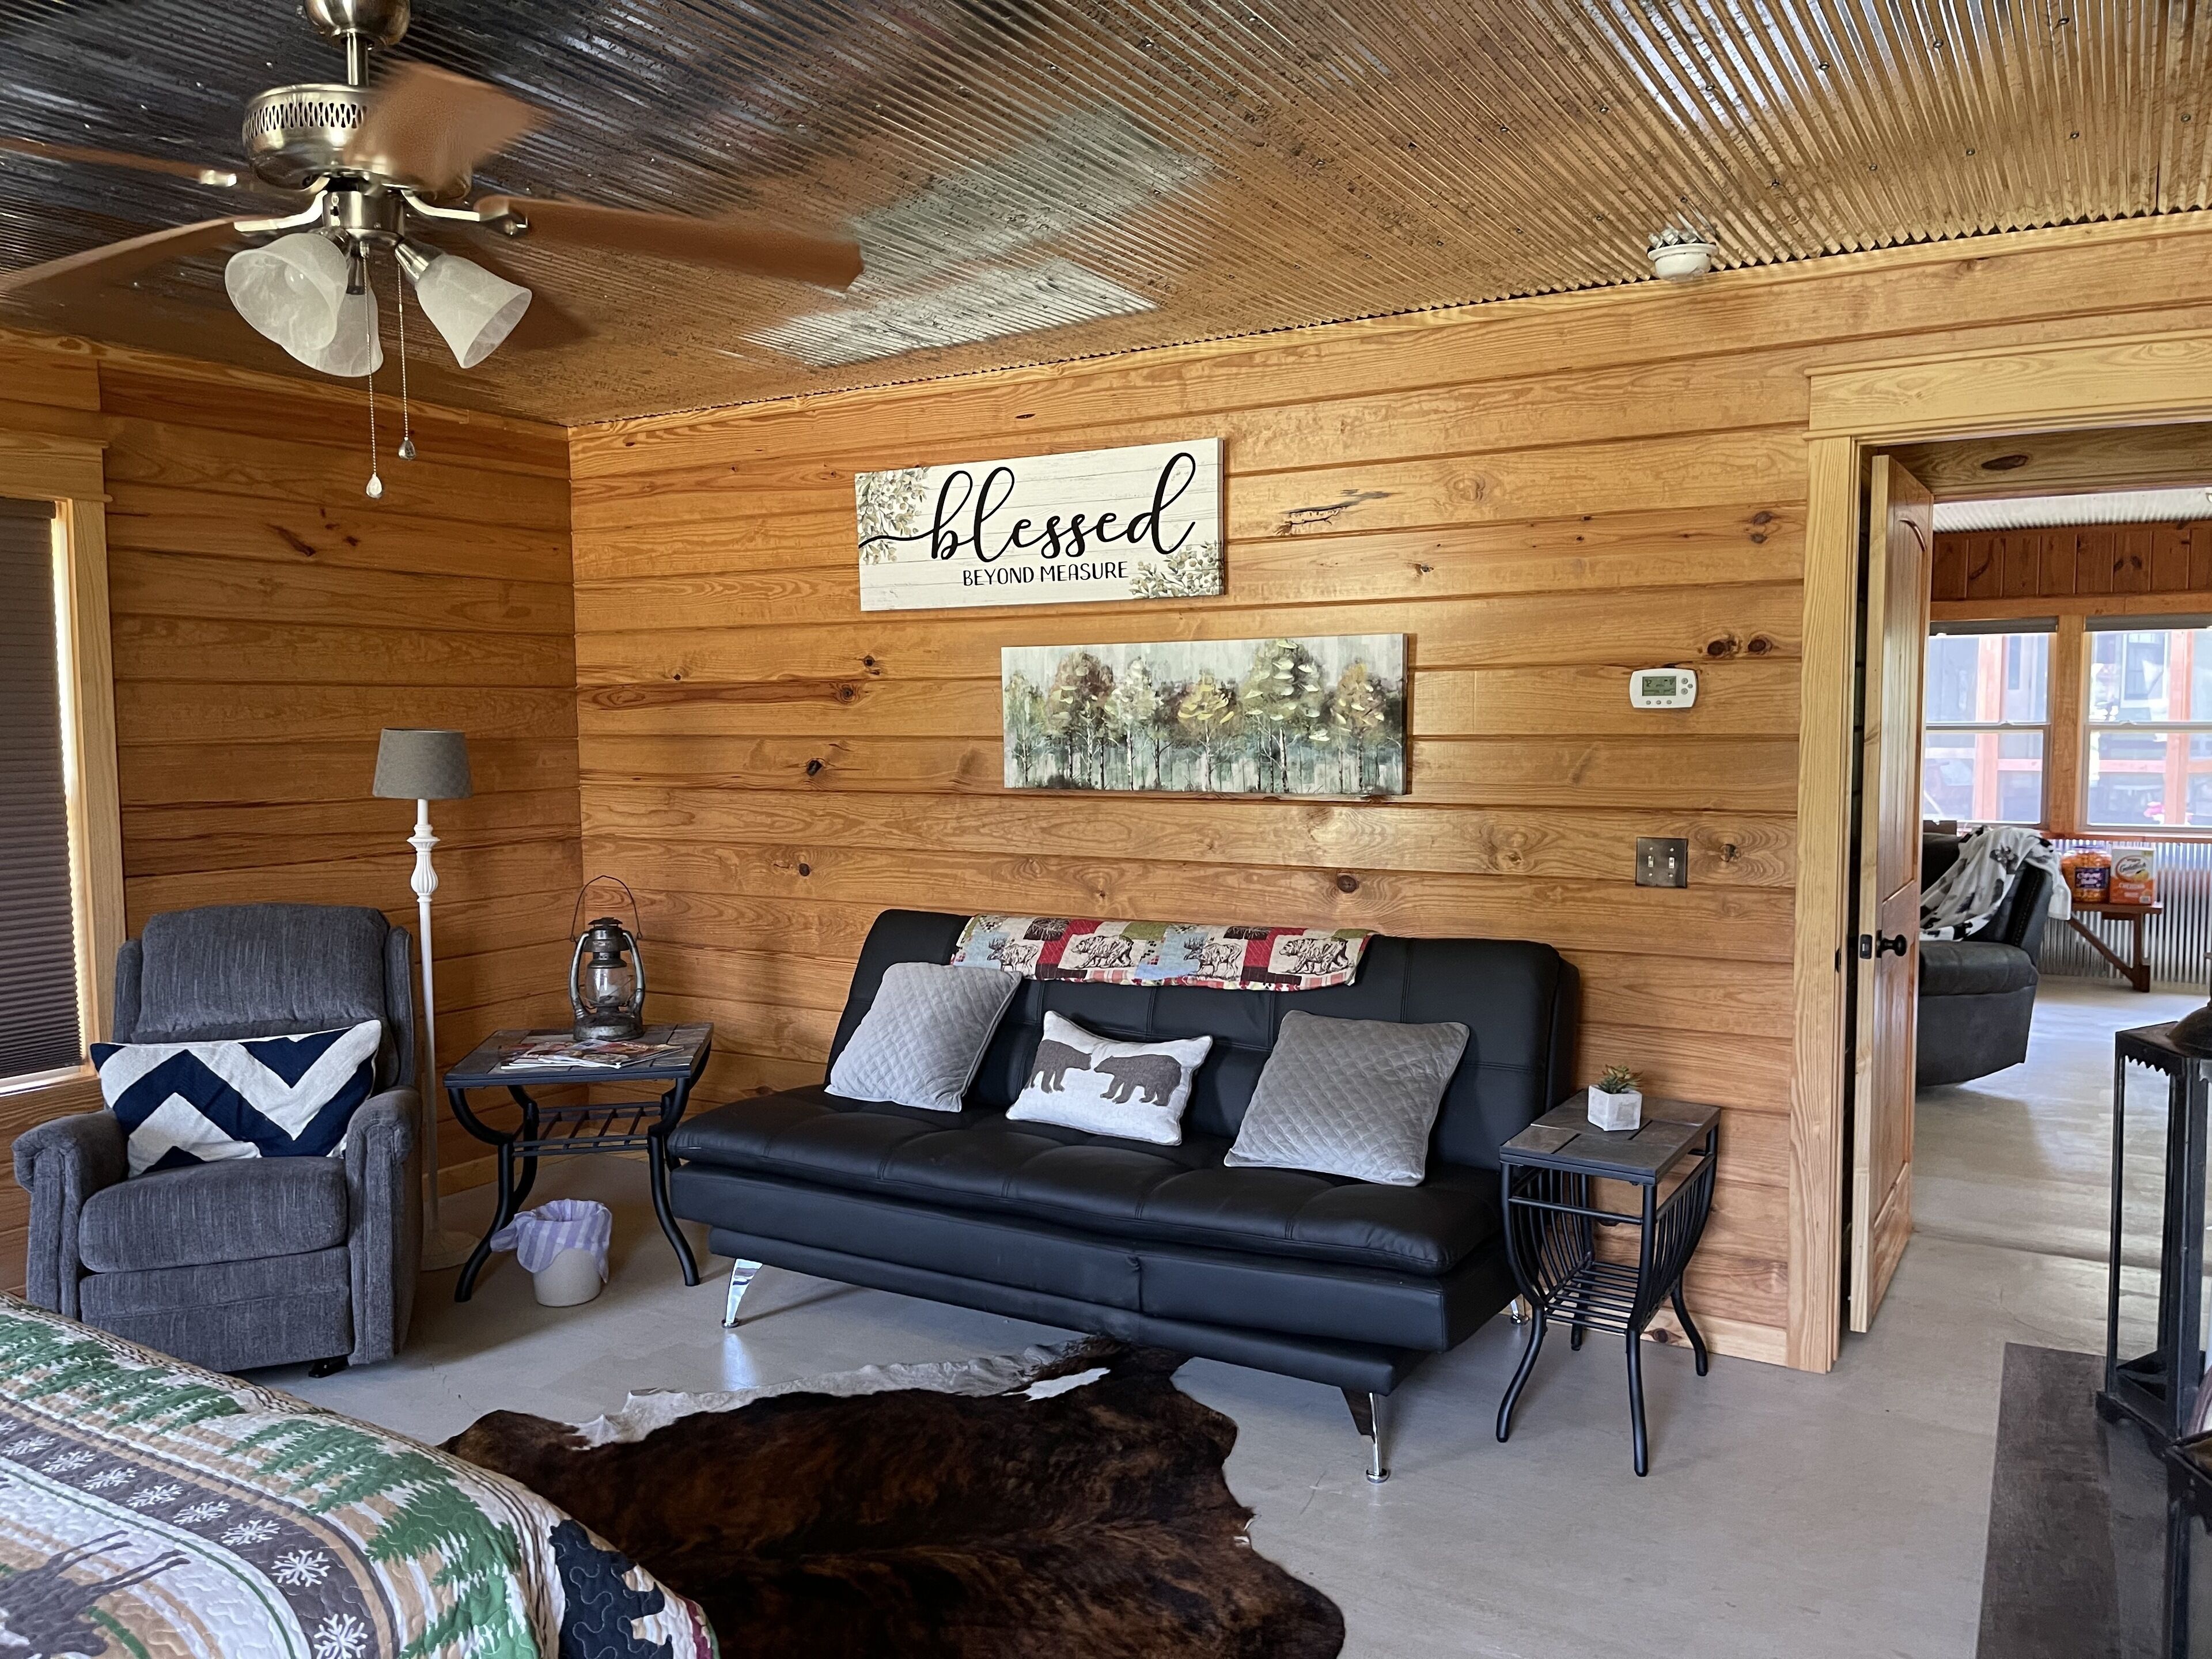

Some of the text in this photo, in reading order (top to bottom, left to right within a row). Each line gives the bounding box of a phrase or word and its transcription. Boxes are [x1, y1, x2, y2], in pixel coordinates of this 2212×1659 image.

[859, 452, 1196, 563] blessed
[963, 560, 1128, 586] BEYOND MEASURE
